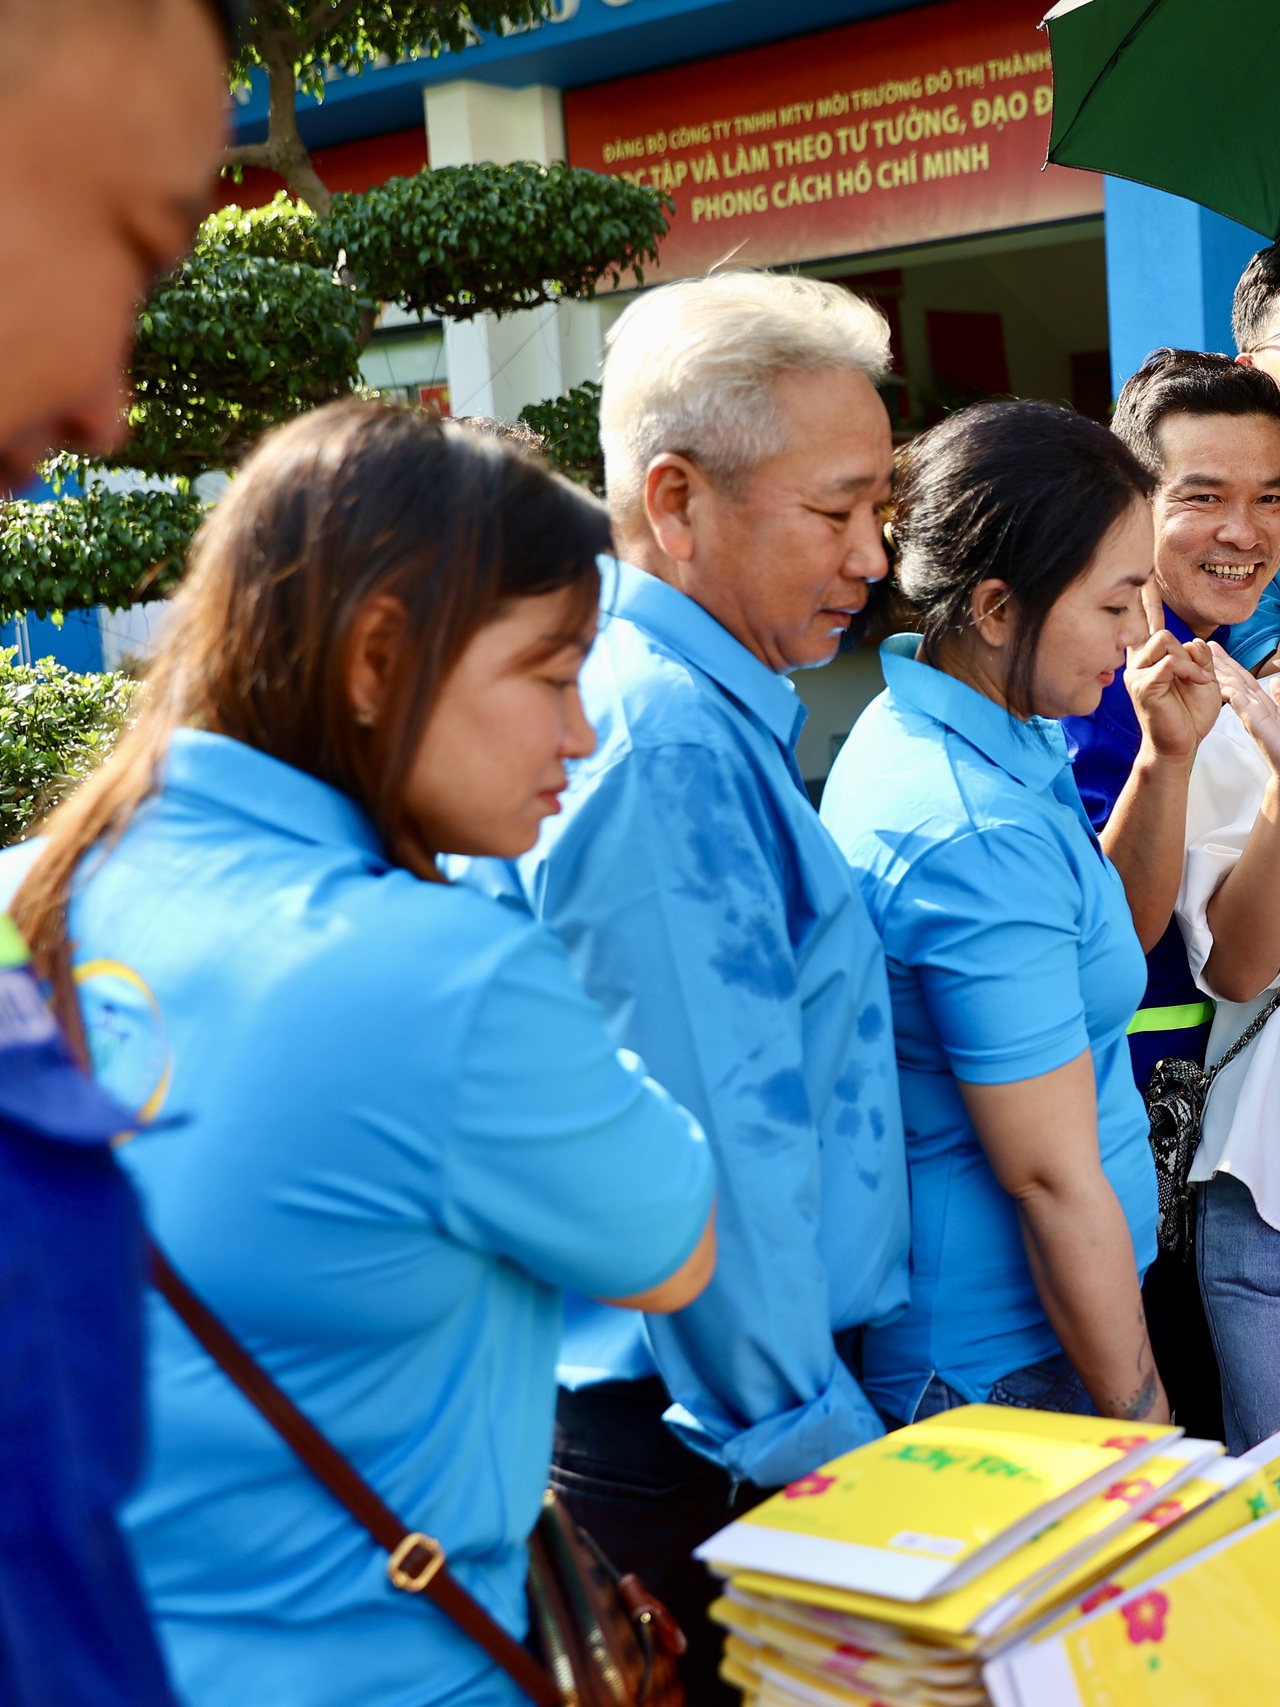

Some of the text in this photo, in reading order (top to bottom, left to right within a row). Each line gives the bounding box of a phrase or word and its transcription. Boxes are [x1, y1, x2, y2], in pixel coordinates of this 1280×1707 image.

[646, 130, 667, 157] BỘ
[669, 125, 711, 150] CÔNG
[713, 118, 732, 140] TY
[734, 109, 777, 136] TNHH
[779, 100, 814, 126] MTV
[817, 90, 849, 119] MÔI
[851, 77, 923, 111] TRƯỜNG
[925, 67, 952, 97] ĐÔ
[955, 63, 985, 89] THỊ
[690, 150, 719, 184] VÀ
[722, 143, 770, 179] LÀM
[771, 131, 833, 168] THEO
[835, 118, 869, 156] TƯ
[871, 103, 967, 151] TƯỞNG,
[971, 90, 1029, 132] ĐẠO
[691, 141, 990, 224] PHONG CÁCH HỒ CHÍ MINH
